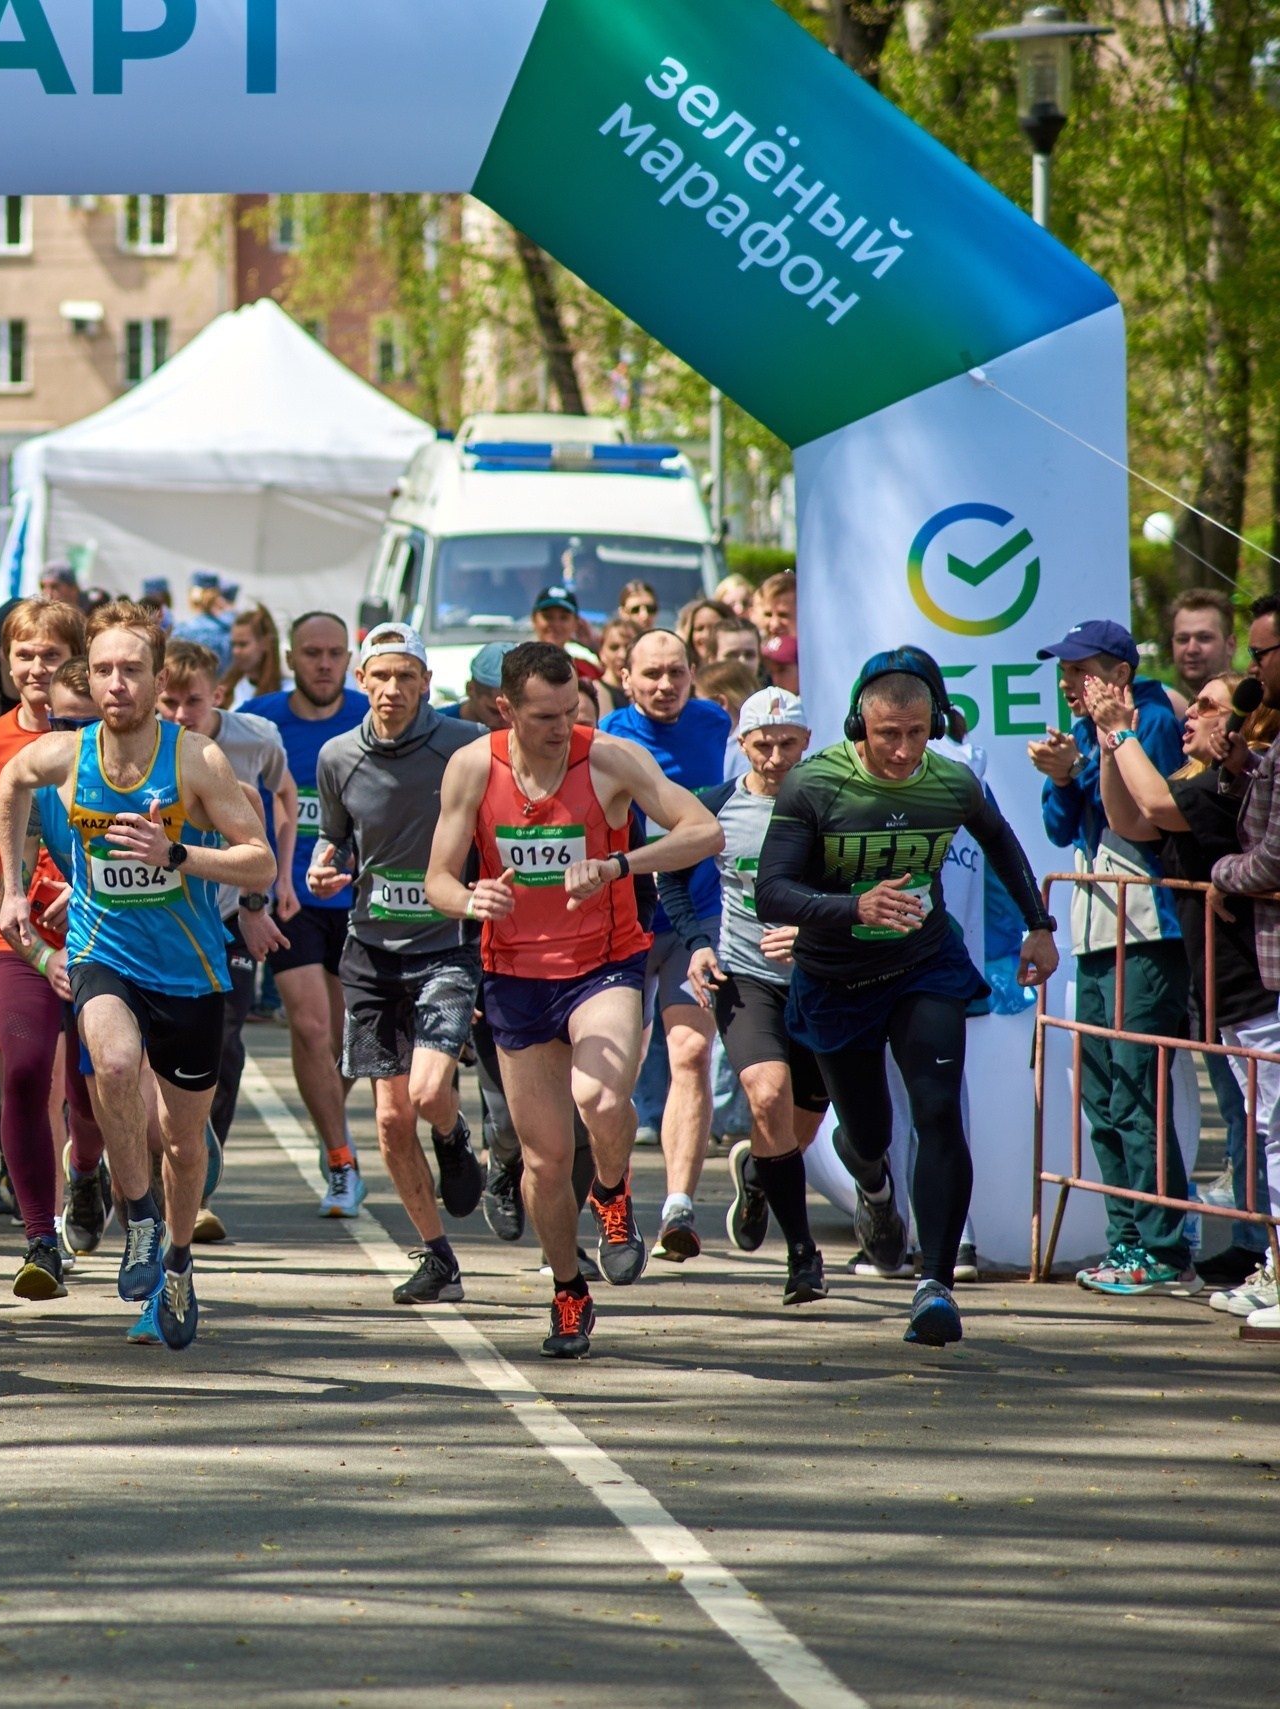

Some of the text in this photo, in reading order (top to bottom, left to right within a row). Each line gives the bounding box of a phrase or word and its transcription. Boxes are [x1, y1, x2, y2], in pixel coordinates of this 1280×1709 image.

[599, 103, 859, 325] марафон
[645, 56, 913, 279] зелёный
[103, 866, 167, 888] 0034
[510, 845, 571, 866] 0196
